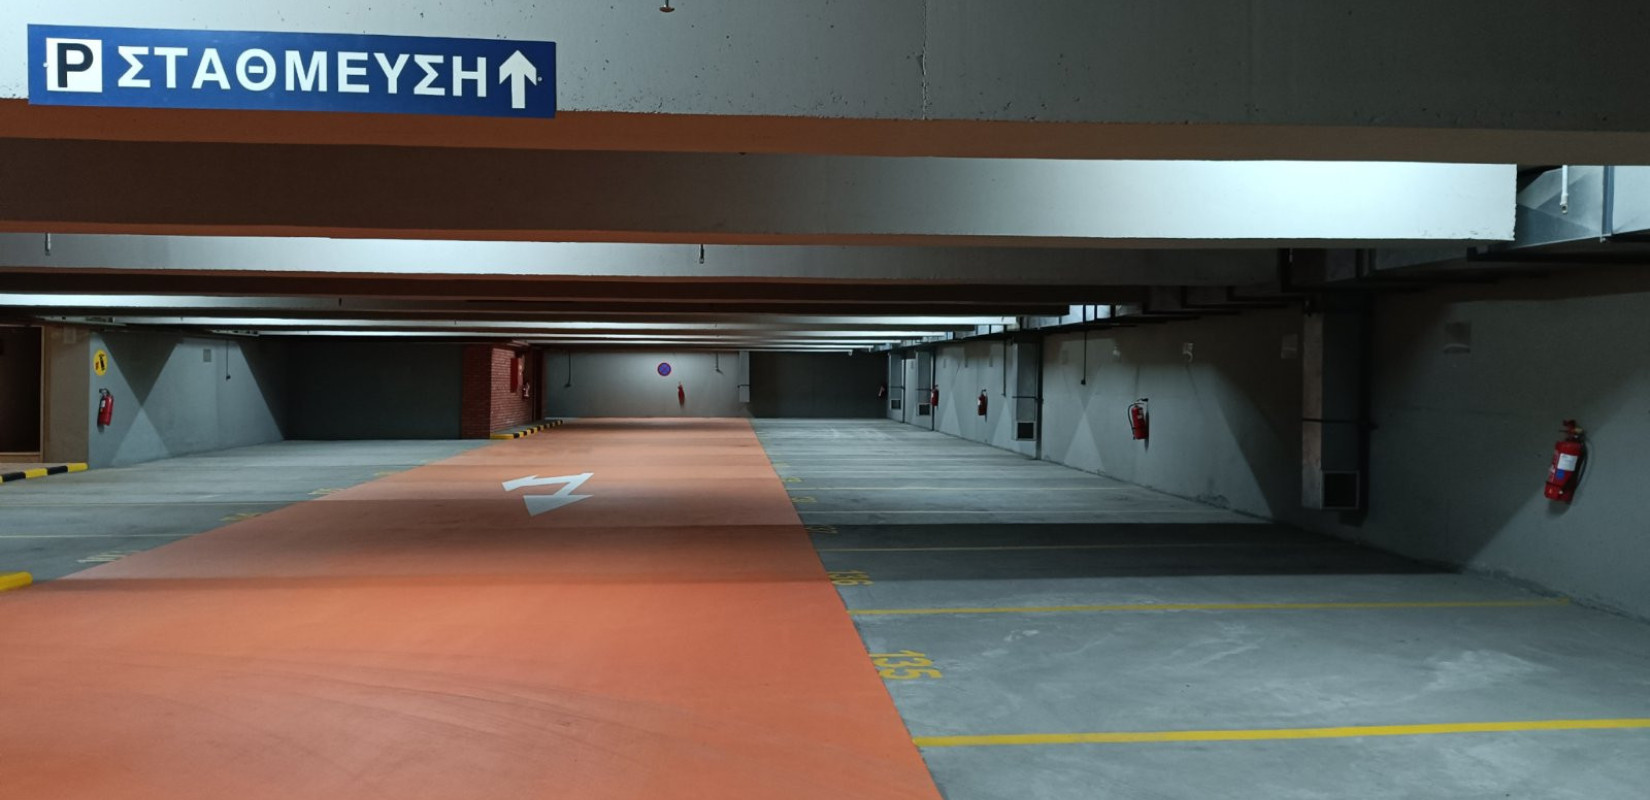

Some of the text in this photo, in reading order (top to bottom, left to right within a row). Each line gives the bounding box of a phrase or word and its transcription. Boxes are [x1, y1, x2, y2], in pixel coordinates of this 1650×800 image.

[117, 45, 487, 98] ΣΤΑΘΜΕΥΣΗ
[827, 569, 875, 586] 136
[868, 649, 943, 680] 135
